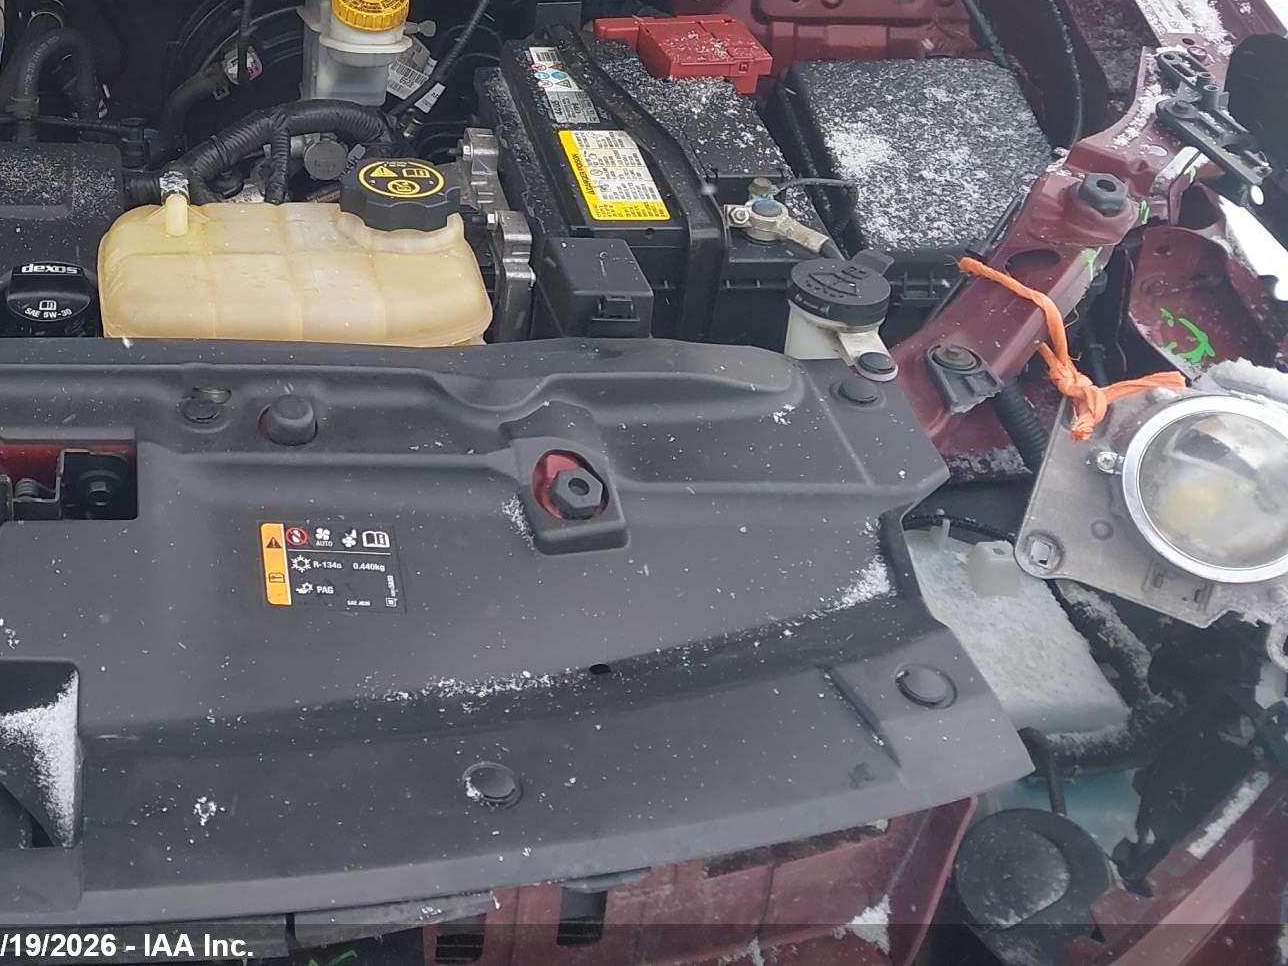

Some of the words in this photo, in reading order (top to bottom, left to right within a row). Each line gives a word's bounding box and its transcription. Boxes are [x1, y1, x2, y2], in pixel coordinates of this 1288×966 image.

[21, 263, 79, 275] dexos
[24, 307, 42, 318] SAE
[43, 308, 73, 319] 5W-30
[316, 585, 334, 594] PAG
